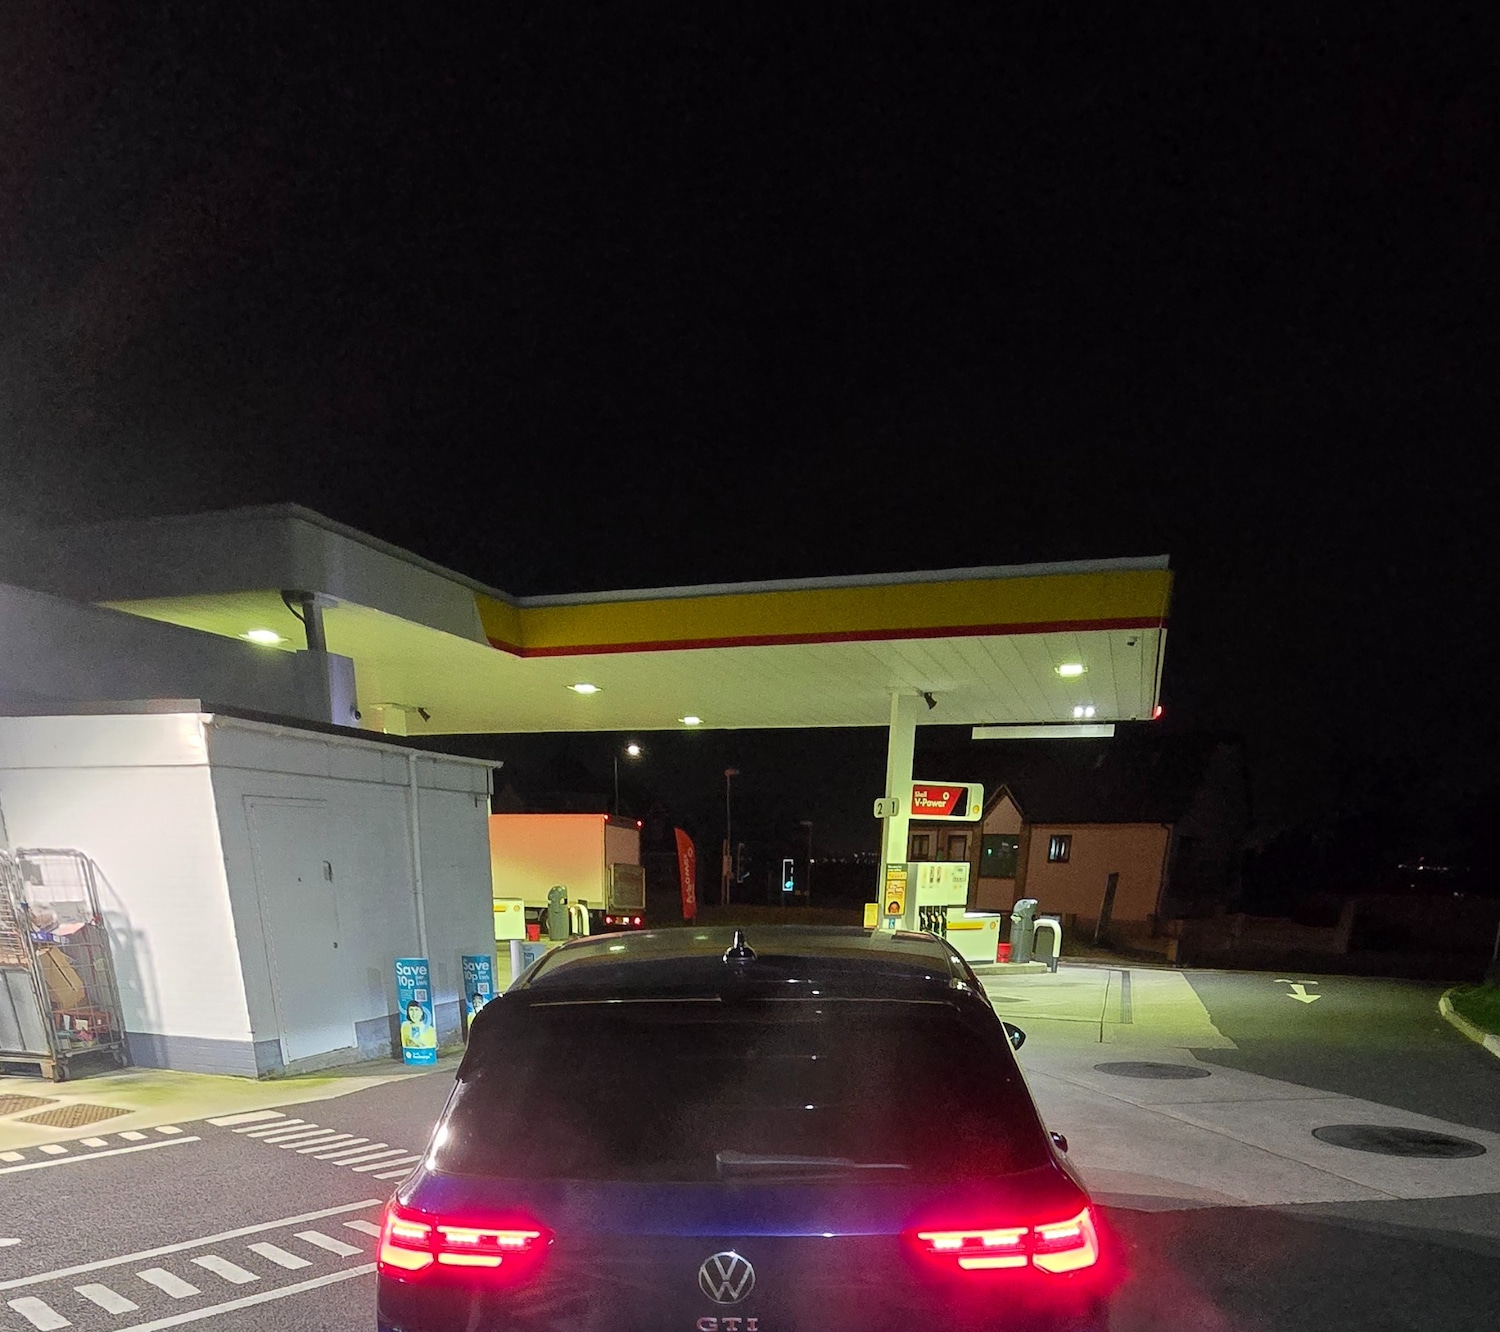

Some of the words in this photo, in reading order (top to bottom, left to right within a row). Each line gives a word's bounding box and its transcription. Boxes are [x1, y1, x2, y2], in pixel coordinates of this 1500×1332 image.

[877, 802, 883, 815] 2
[891, 801, 896, 814] 1
[914, 798, 947, 808] V-Power
[396, 962, 427, 976] Save
[463, 958, 490, 971] Save
[397, 976, 415, 989] 10p
[464, 970, 478, 983] 10p
[696, 1317, 758, 1332] GTI
